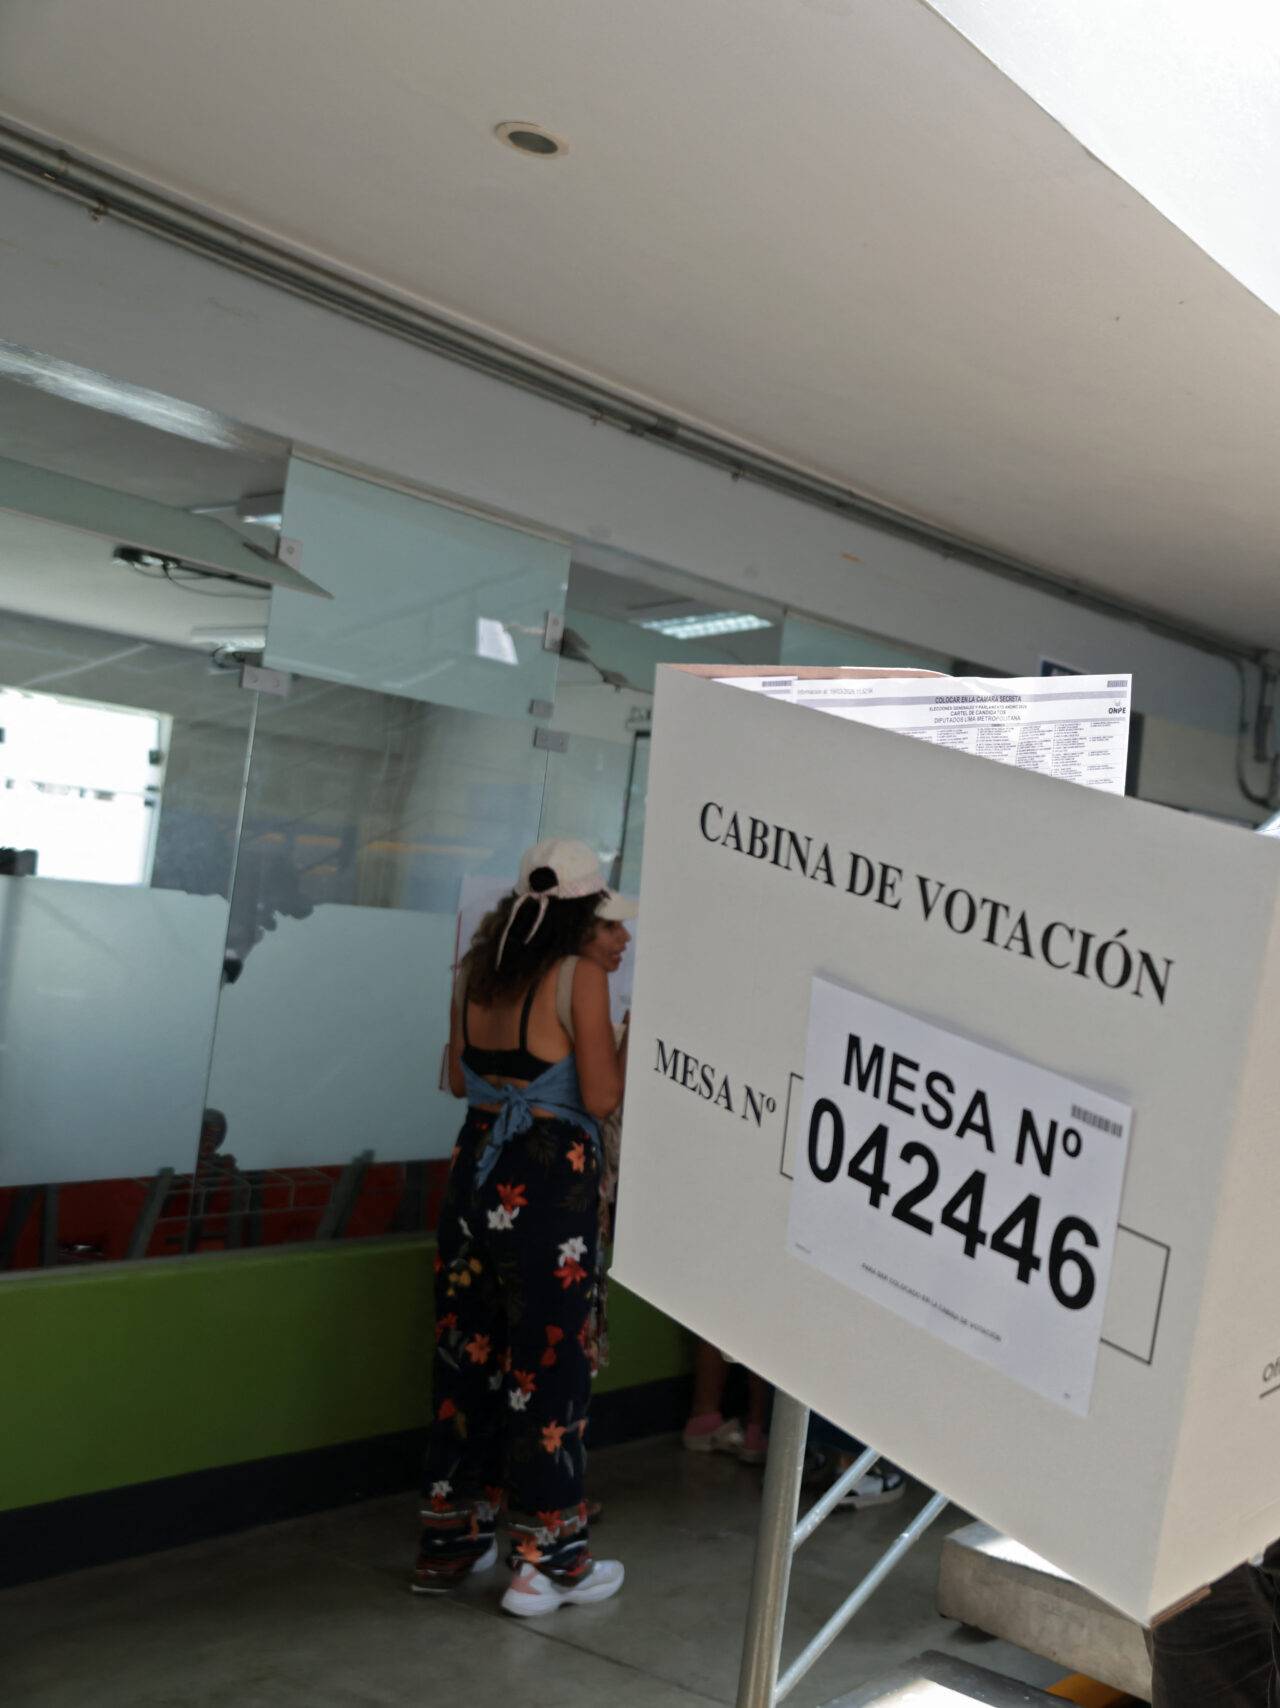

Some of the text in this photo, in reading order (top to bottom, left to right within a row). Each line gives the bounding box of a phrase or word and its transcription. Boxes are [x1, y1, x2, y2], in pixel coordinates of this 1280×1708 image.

[935, 696, 960, 704] COLOCAR
[700, 801, 1175, 1006] CABINA DE VOTACIÓN
[654, 1038, 734, 1113] MESA
[843, 1033, 996, 1153] MESA
[807, 1097, 1100, 1311] 042446
